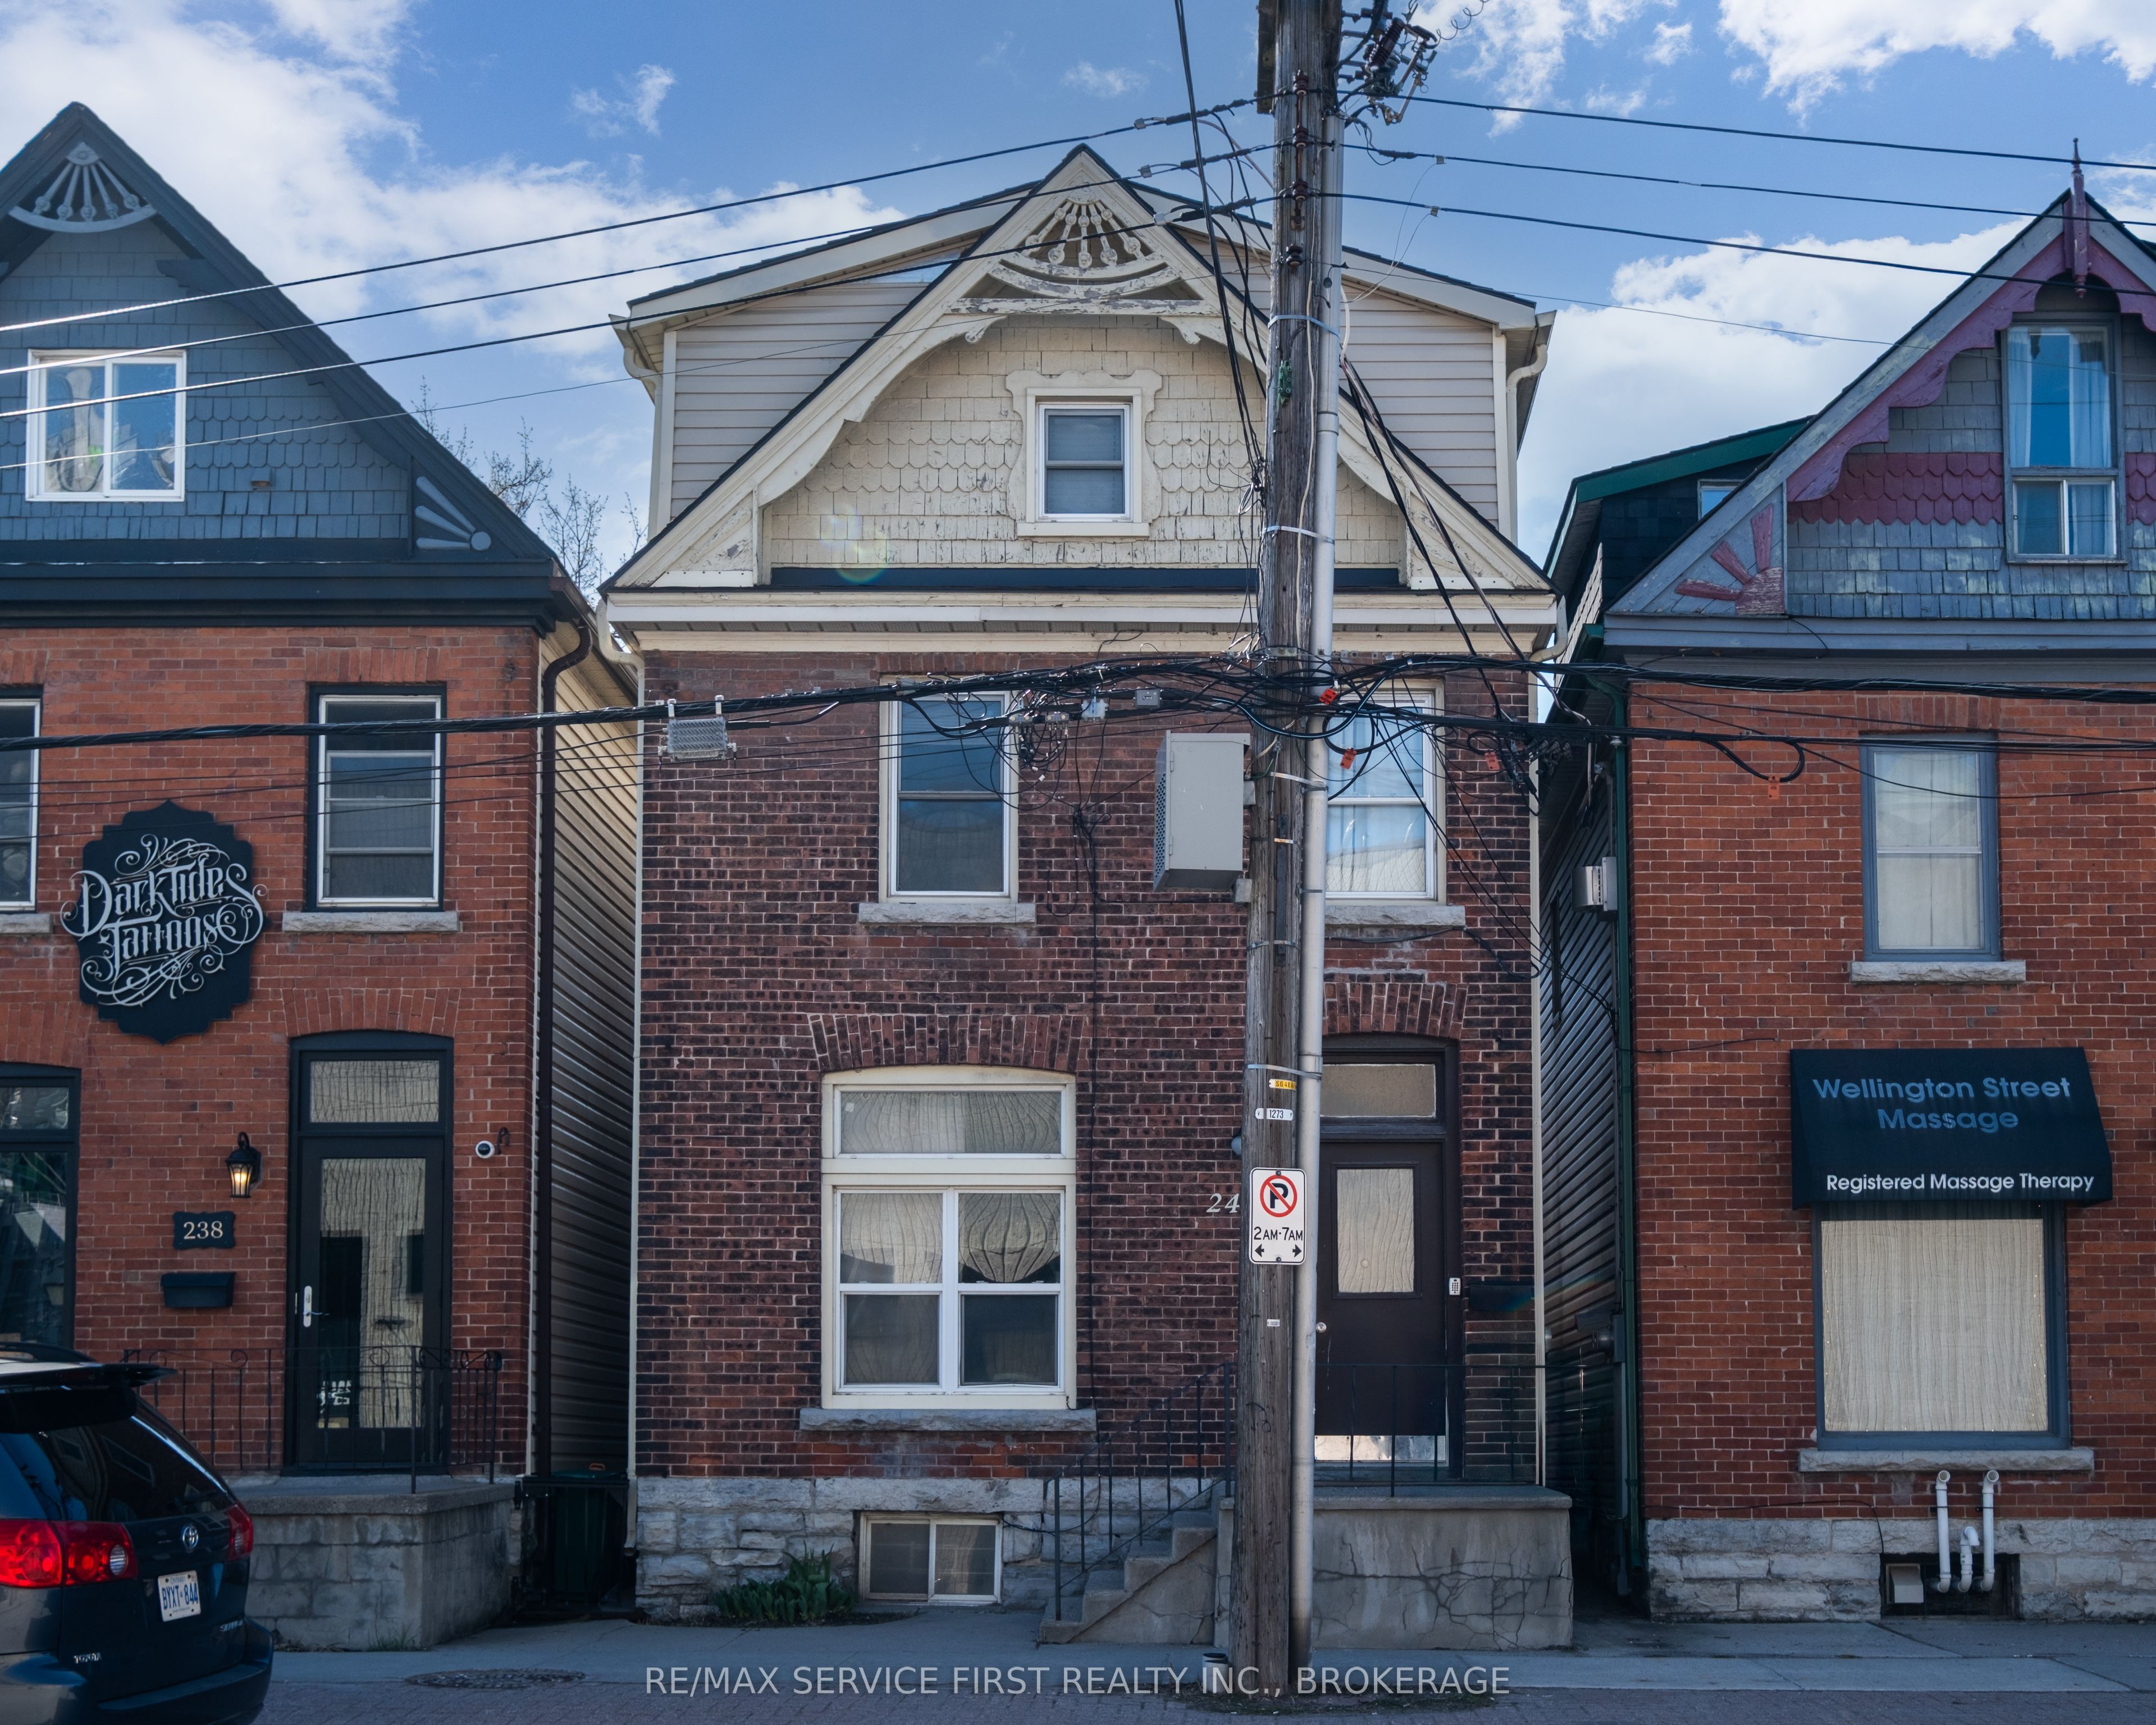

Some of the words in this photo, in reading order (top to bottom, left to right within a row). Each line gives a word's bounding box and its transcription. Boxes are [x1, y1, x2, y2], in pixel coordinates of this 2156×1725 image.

[98, 913, 218, 983] Tattoos
[1813, 1078, 1974, 1103] Wellington
[1984, 1077, 2070, 1098] Street
[1269, 1110, 1283, 1119] 1273
[1878, 1109, 2018, 1133] Massage
[1827, 1174, 1925, 1194] Registered
[1930, 1174, 2015, 1193] Massage
[2020, 1173, 2094, 1192] Therapy
[184, 1221, 223, 1239] 238
